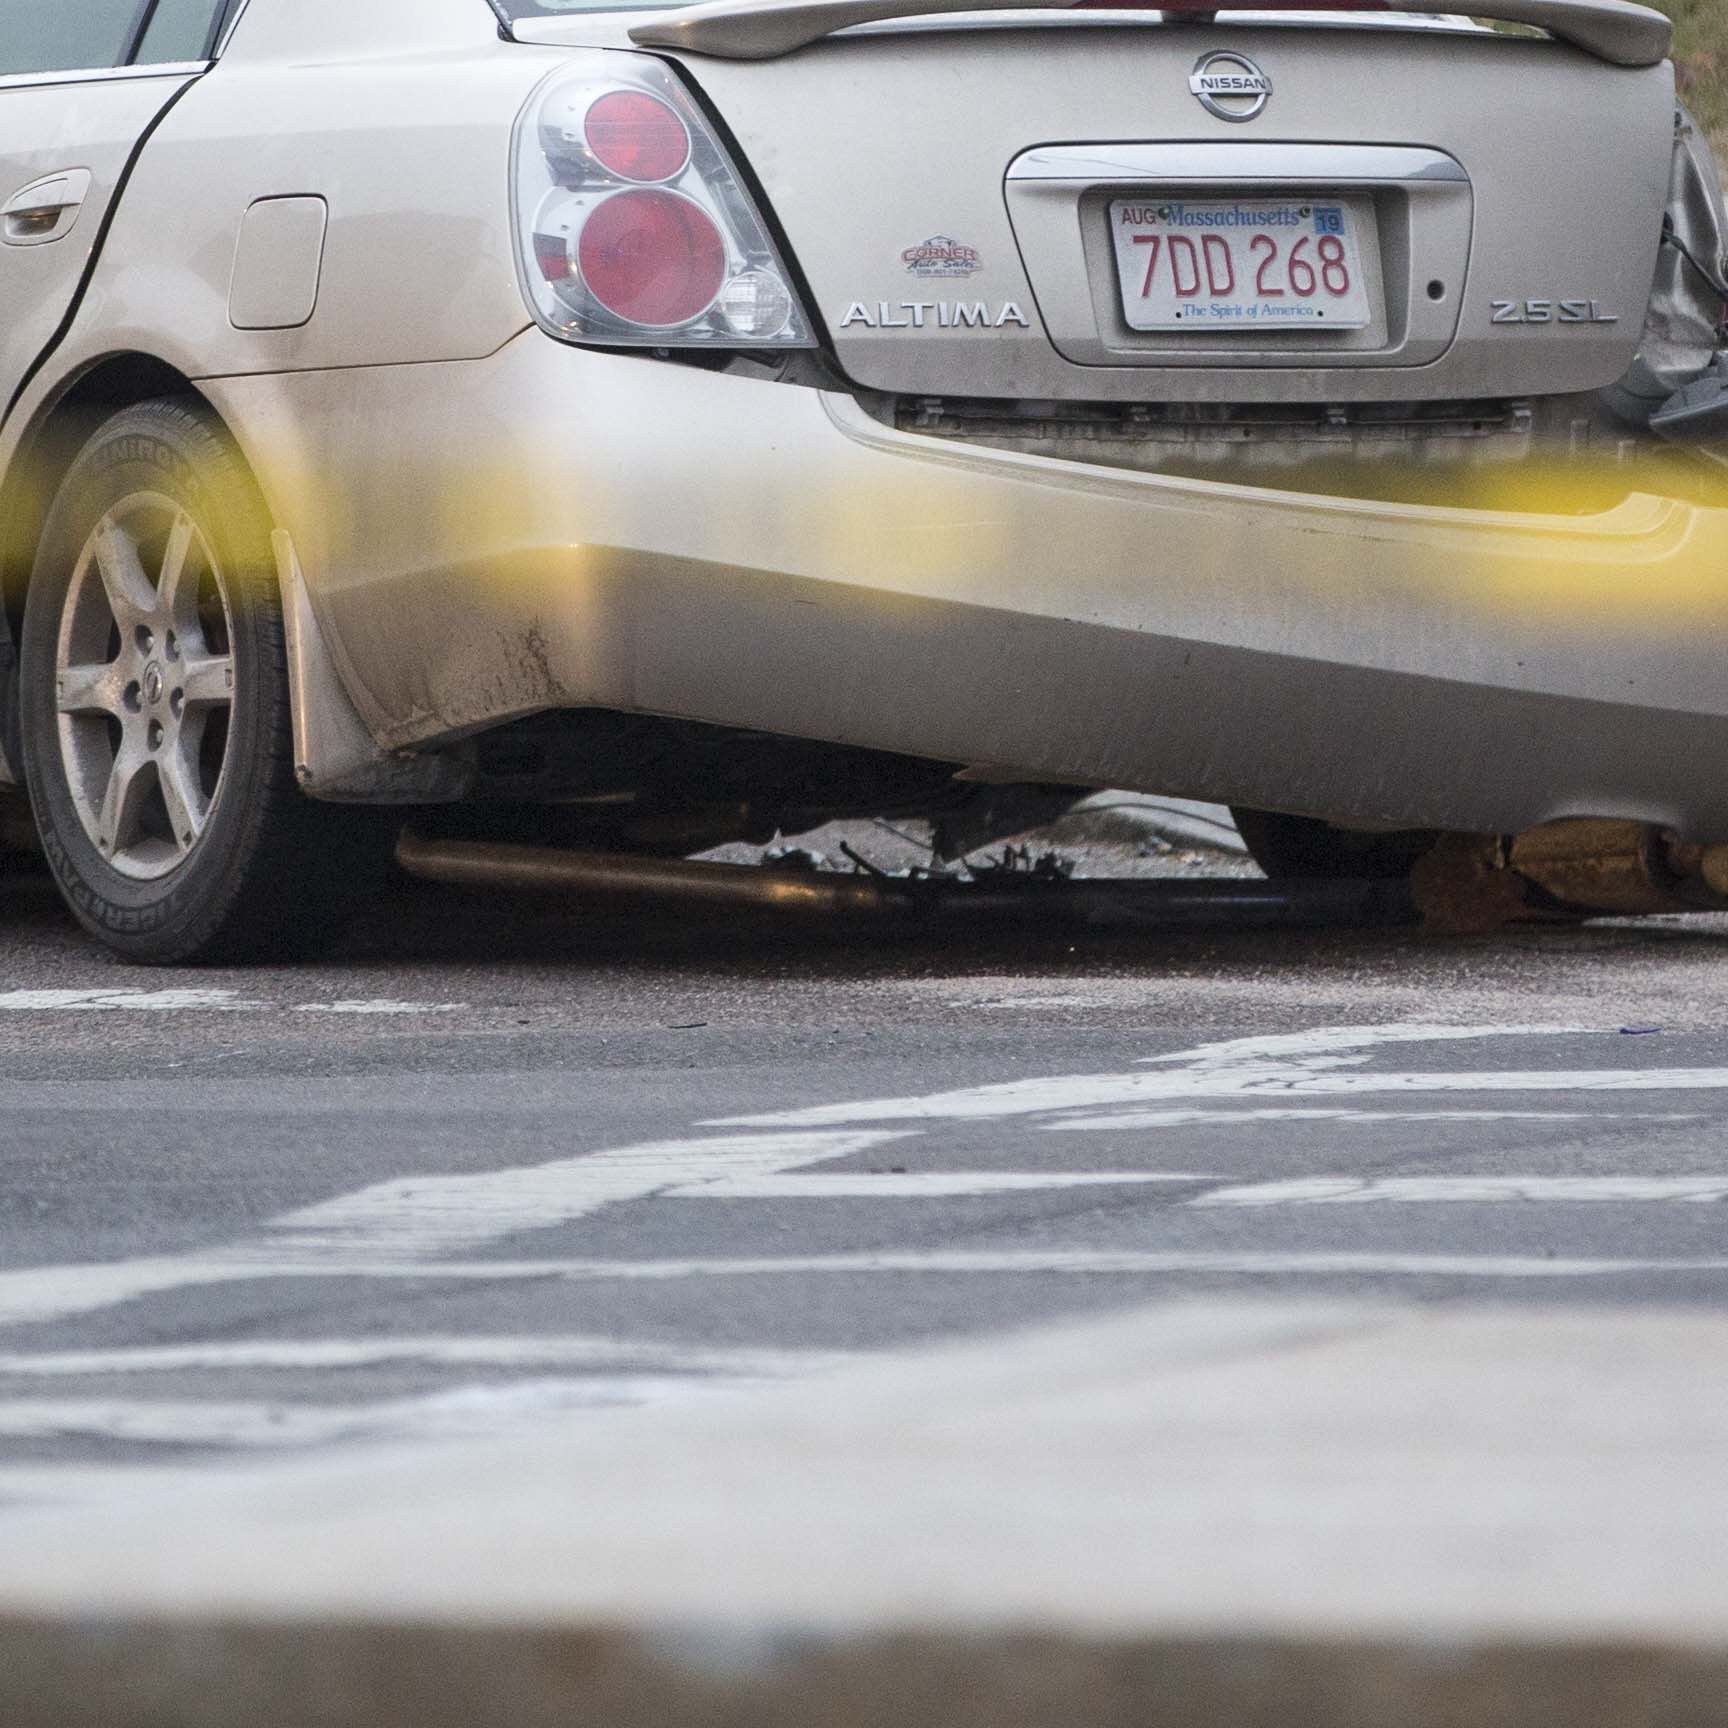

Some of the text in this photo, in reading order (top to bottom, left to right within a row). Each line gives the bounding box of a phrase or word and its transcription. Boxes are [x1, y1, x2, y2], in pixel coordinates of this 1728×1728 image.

[1200, 77, 1267, 90] NISSAN
[1122, 208, 1157, 225] AUG
[1167, 204, 1301, 227] Massachusetts
[1319, 214, 1340, 233] 19
[902, 247, 977, 262] CORNER
[1132, 233, 1350, 299] 7DD 268
[839, 301, 1031, 329] ALTIMA
[1183, 303, 1315, 320] The Spirit of America
